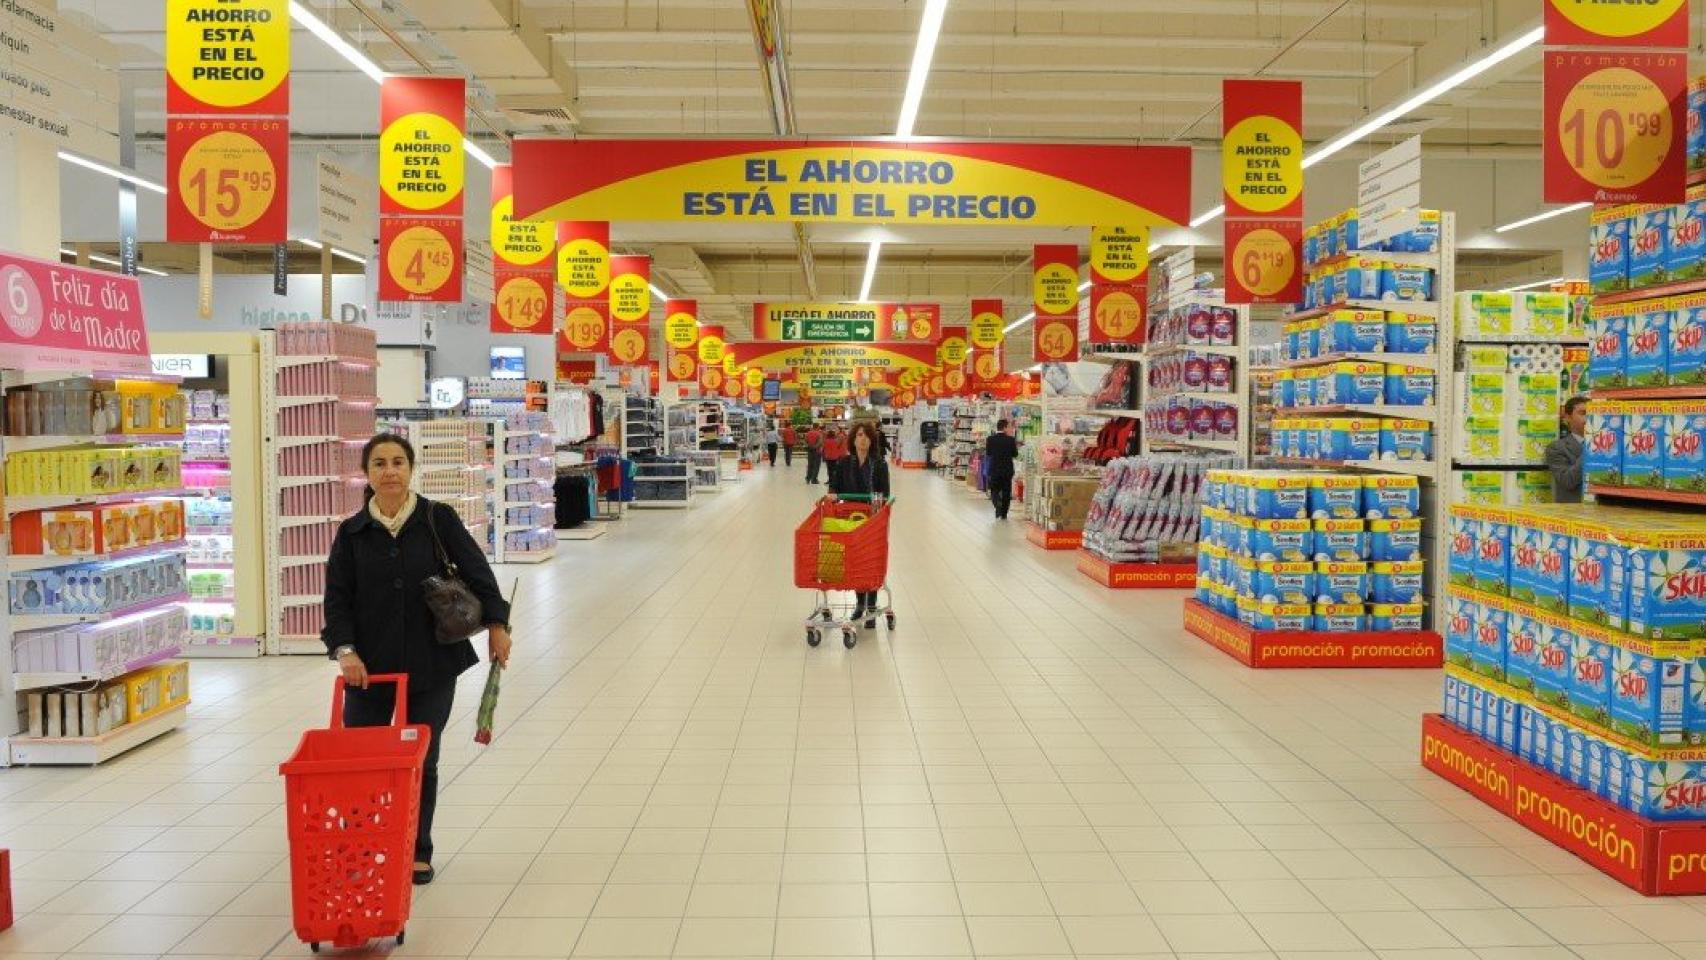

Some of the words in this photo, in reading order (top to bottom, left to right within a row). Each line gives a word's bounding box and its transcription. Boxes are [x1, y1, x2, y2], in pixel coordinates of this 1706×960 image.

[187, 9, 272, 23] AHORRO
[203, 26, 255, 43] ESTÁ
[200, 47, 227, 61] EN
[233, 47, 257, 61] EL
[1556, 55, 1677, 68] promoción
[193, 66, 265, 81] PRECIO
[414, 130, 430, 140] EL
[1255, 133, 1270, 142] EL
[393, 143, 451, 153] AHORRO
[1236, 146, 1291, 155] AHORRO
[404, 153, 440, 166] ESTÁ
[1247, 157, 1280, 168] ESTÁ
[402, 169, 421, 180] EN
[426, 169, 442, 180] EL
[745, 159, 787, 183] EL
[799, 159, 954, 185] AHORRO
[1245, 172, 1262, 181] EN
[1266, 172, 1282, 181] EL
[397, 182, 447, 193] PRECIO
[1240, 185, 1287, 195] PRECIO
[683, 185, 775, 216] ESTÁ
[789, 193, 838, 217] EN
[853, 193, 895, 217] EL
[908, 194, 1036, 219] PRECIO
[508, 235, 523, 243] EN
[526, 235, 538, 243] EL
[504, 244, 542, 253] PRECIO
[1102, 262, 1138, 270] PRECIO
[7, 269, 28, 315] 6
[50, 270, 94, 306] Feliz
[100, 279, 129, 312] día
[49, 307, 66, 331] de
[68, 310, 82, 333] la
[82, 315, 141, 352] Madre
[1115, 571, 1172, 583] promoción
[1261, 642, 1345, 660] promoción
[1352, 642, 1435, 660] promoción
[1423, 733, 1510, 800] promoción
[1516, 784, 1636, 870] promoción
